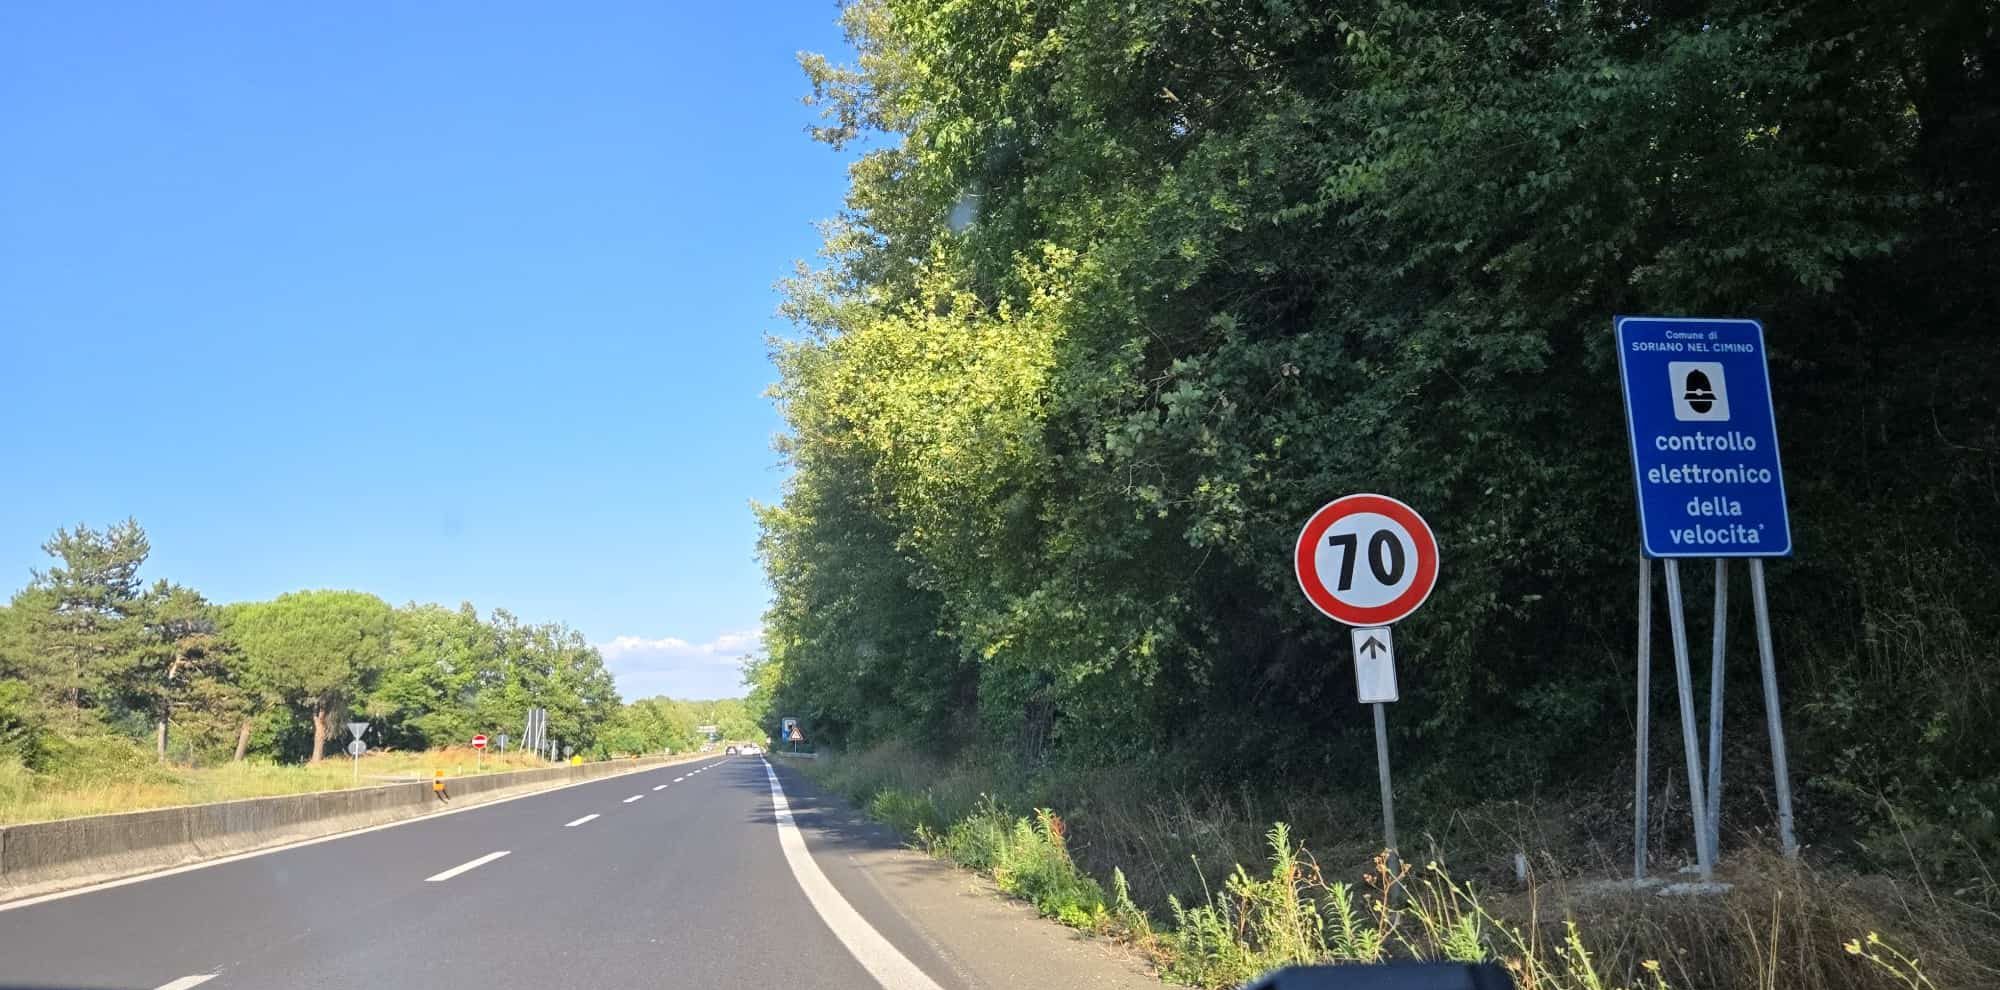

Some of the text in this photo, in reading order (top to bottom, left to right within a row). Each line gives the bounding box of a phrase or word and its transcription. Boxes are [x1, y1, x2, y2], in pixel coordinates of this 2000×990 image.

[1665, 330, 1718, 340] Comune di
[1632, 342, 1754, 353] SORIANO NEL CIMINO
[1655, 431, 1756, 451] controllo
[1648, 463, 1771, 483] elettronico
[1686, 496, 1742, 516] della
[1670, 523, 1764, 544] velocita'
[1328, 529, 1405, 591] 70
